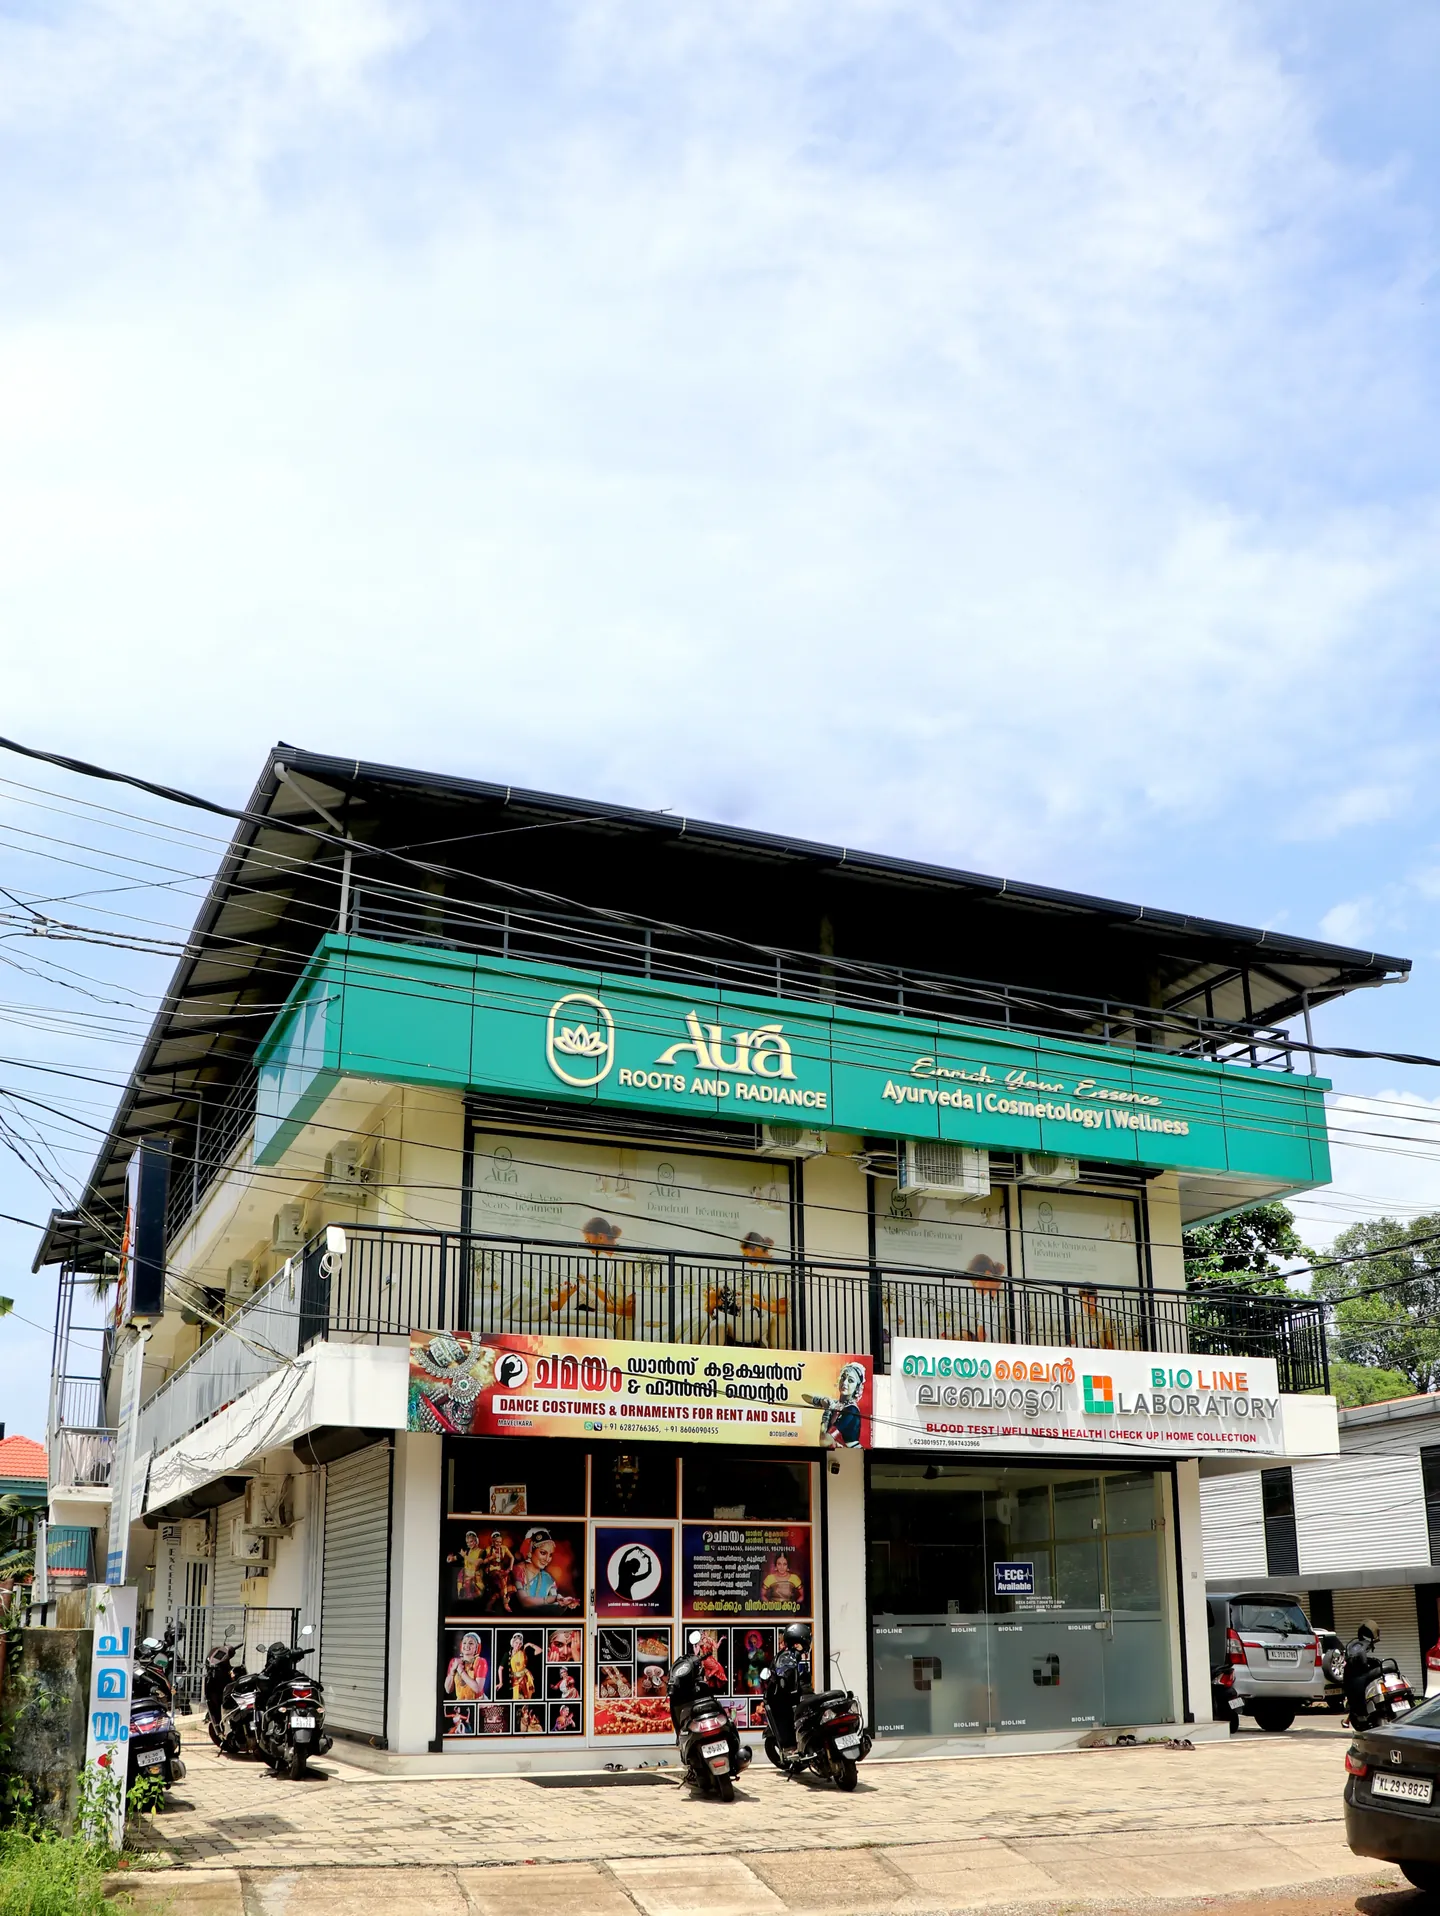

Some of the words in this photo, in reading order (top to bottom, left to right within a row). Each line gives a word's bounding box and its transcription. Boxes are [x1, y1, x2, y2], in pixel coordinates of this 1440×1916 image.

[618, 1068, 686, 1093] ROOTS
[690, 1077, 730, 1098] AND
[735, 1081, 828, 1109] RADIANCE
[909, 1056, 995, 1085] Enrich
[1003, 1069, 1064, 1093] Your
[1073, 1079, 1163, 1106] Essence
[881, 1079, 975, 1110] Ayurveda
[984, 1092, 1104, 1130] Cosmetology
[1111, 1108, 1190, 1136] Wellness
[533, 1354, 622, 1393] ചമയം
[627, 1357, 699, 1377] ഡാൻസ്
[500, 1398, 539, 1413] DANCE
[542, 1400, 605, 1416] COSTUMES
[608, 1405, 618, 1416] &
[620, 1404, 689, 1420] ORNAMENTS
[692, 1407, 713, 1420] FOR
[716, 1408, 743, 1421] RENT
[746, 1409, 769, 1423] AND
[771, 1411, 797, 1424] SALE
[1117, 1392, 1279, 1420] LABORATORY
[498, 1419, 533, 1427] MAVELIKARA
[926, 1423, 964, 1434] BLOOD
[967, 1425, 995, 1435] TEST
[1062, 1429, 1102, 1439] HEALTH
[1109, 1430, 1143, 1440] CHECK
[1146, 1431, 1159, 1440] UP
[1166, 1432, 1194, 1441] HOME
[1196, 1432, 1257, 1443] COLLECTION
[1004, 1569, 1024, 1581] ECG
[997, 1582, 1032, 1592] Available
[1379, 1777, 1388, 1791] KL
[1390, 1779, 1401, 1793] 29
[1401, 1781, 1407, 1794] S
[1407, 1783, 1430, 1798] 8825
